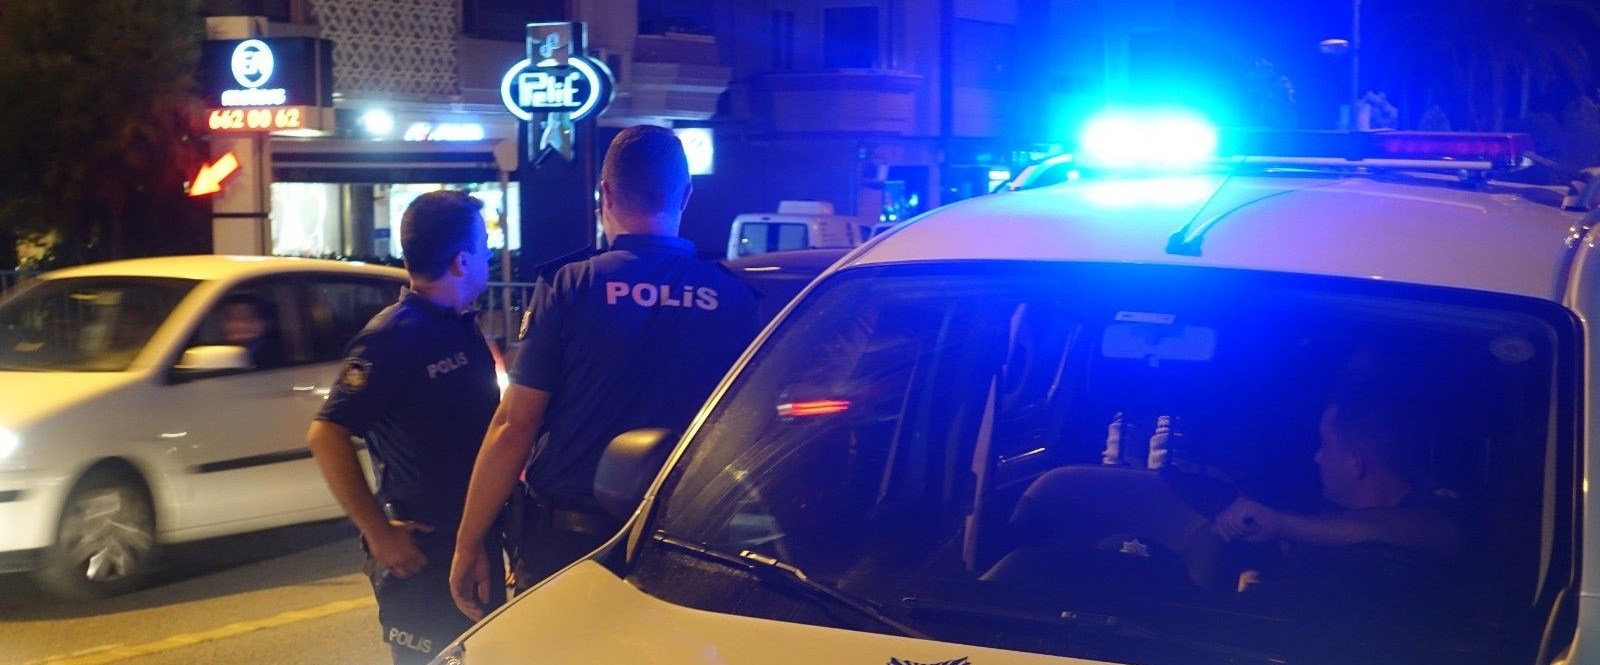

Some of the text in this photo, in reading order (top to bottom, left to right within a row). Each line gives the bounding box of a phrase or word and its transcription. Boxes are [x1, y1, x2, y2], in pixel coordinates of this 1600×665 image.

[208, 107, 301, 129] 662 00 62
